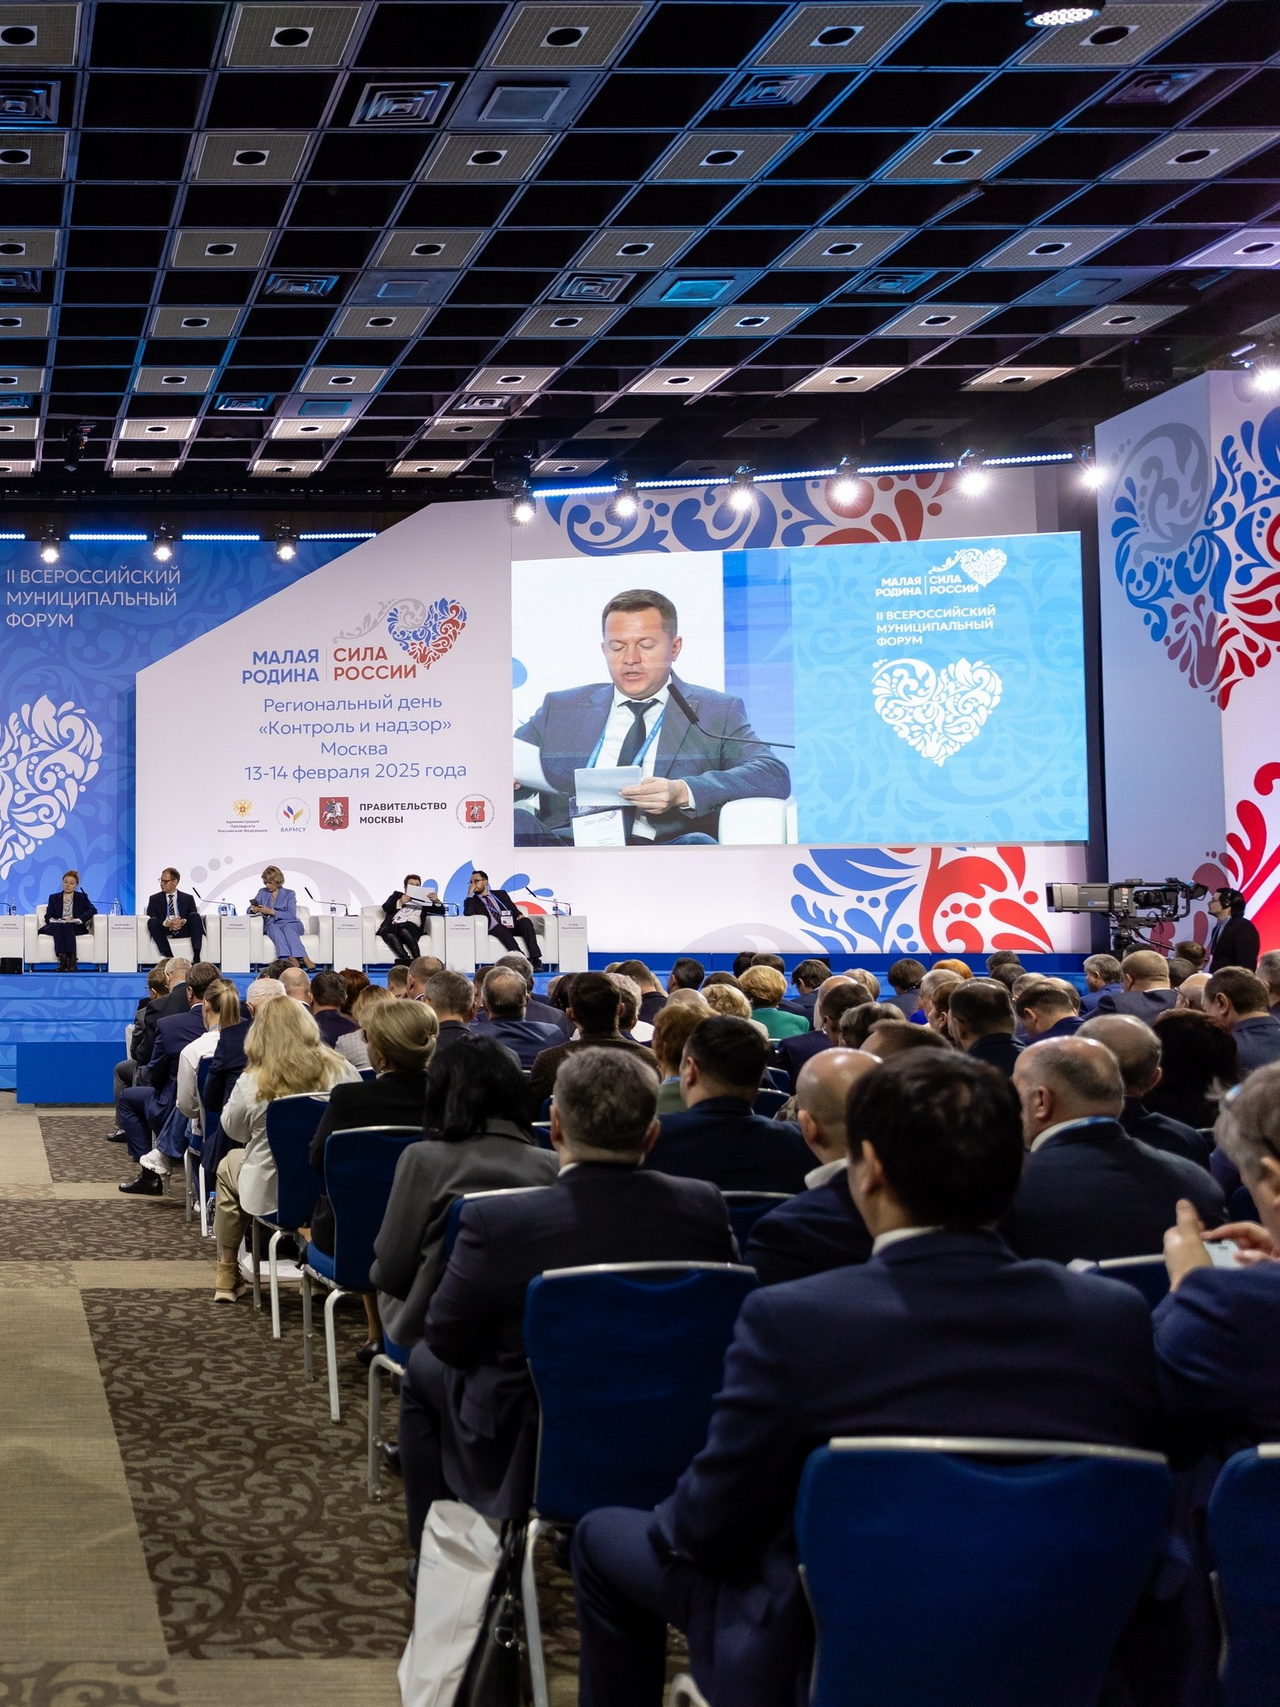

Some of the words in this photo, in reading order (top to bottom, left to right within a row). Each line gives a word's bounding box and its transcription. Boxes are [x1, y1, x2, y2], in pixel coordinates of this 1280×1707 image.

[6, 569, 15, 584] II
[20, 565, 181, 585] ВСЕРОССИЙСКИЙ
[881, 576, 922, 587] МАЛАЯ
[929, 574, 962, 585] СИЛА
[875, 587, 923, 598] РОДИНА
[929, 584, 979, 595] РОССИИ
[6, 587, 177, 609] МУНИЦИПАЛЬНЫЙ
[6, 612, 74, 628] ФОРУМ
[876, 611, 884, 621] II
[886, 604, 996, 621] ВСЕРОССИЙСКИЙ
[876, 617, 994, 634] МУНИЦИПАЛЬНЫЙ
[876, 635, 923, 647] ФОРУМ
[252, 649, 320, 666] МАЛАЯ
[333, 646, 388, 662] СИЛА
[242, 667, 320, 685] РОДИНА
[333, 664, 417, 682] РОССИИ
[263, 694, 394, 713] Региональный
[397, 697, 443, 712] день
[258, 720, 355, 738] «Контроль
[359, 721, 370, 732] и
[375, 719, 452, 735] надзор»
[320, 742, 388, 756] Москва
[244, 765, 288, 781] 13-14
[292, 764, 370, 783] февраля
[375, 762, 420, 779] 2025
[425, 765, 467, 780] года
[359, 802, 448, 811] ПРАВИТЕЛЬСТВО
[359, 816, 404, 824] МОСКВЫ
